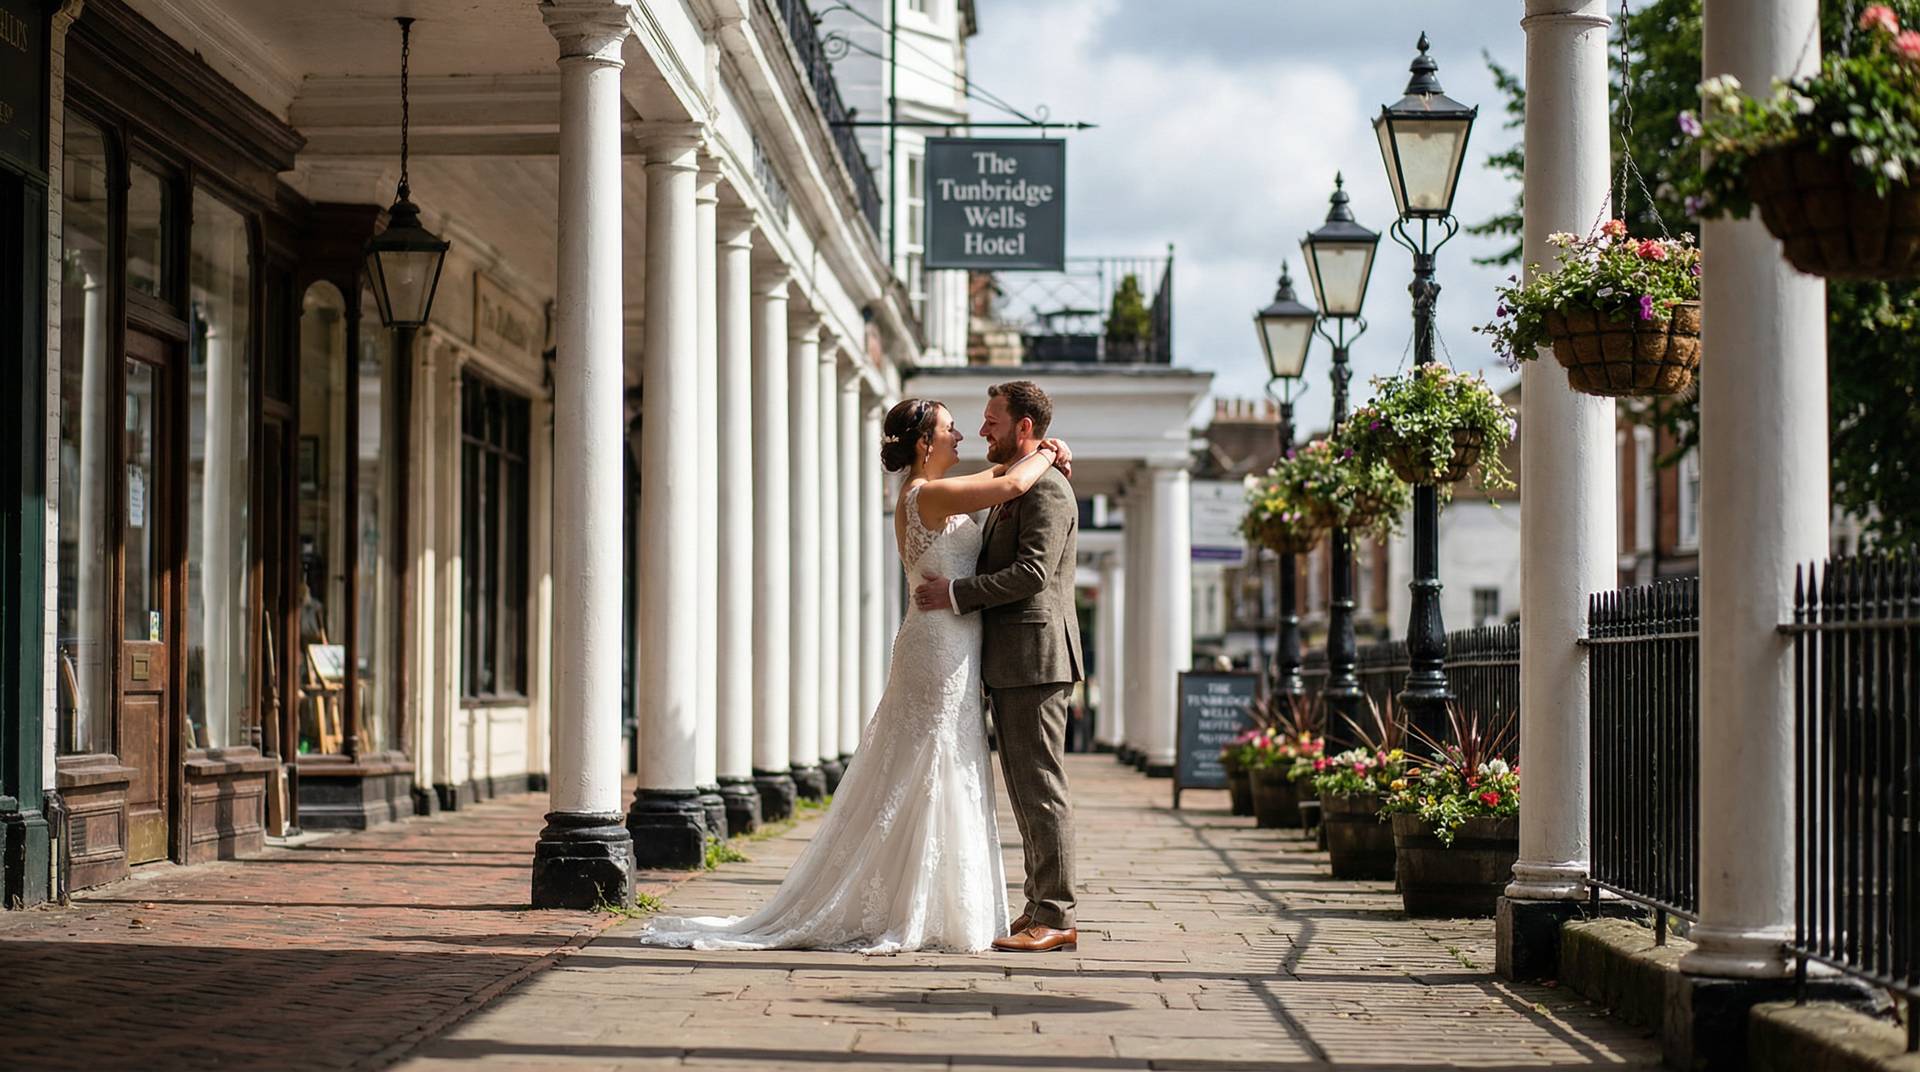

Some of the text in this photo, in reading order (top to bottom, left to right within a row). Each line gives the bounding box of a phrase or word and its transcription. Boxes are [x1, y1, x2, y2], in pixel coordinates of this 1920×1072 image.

[972, 151, 1017, 174] The
[937, 178, 1053, 207] Tunbridge
[964, 205, 1027, 228] Wells
[964, 232, 1025, 255] Hotel
